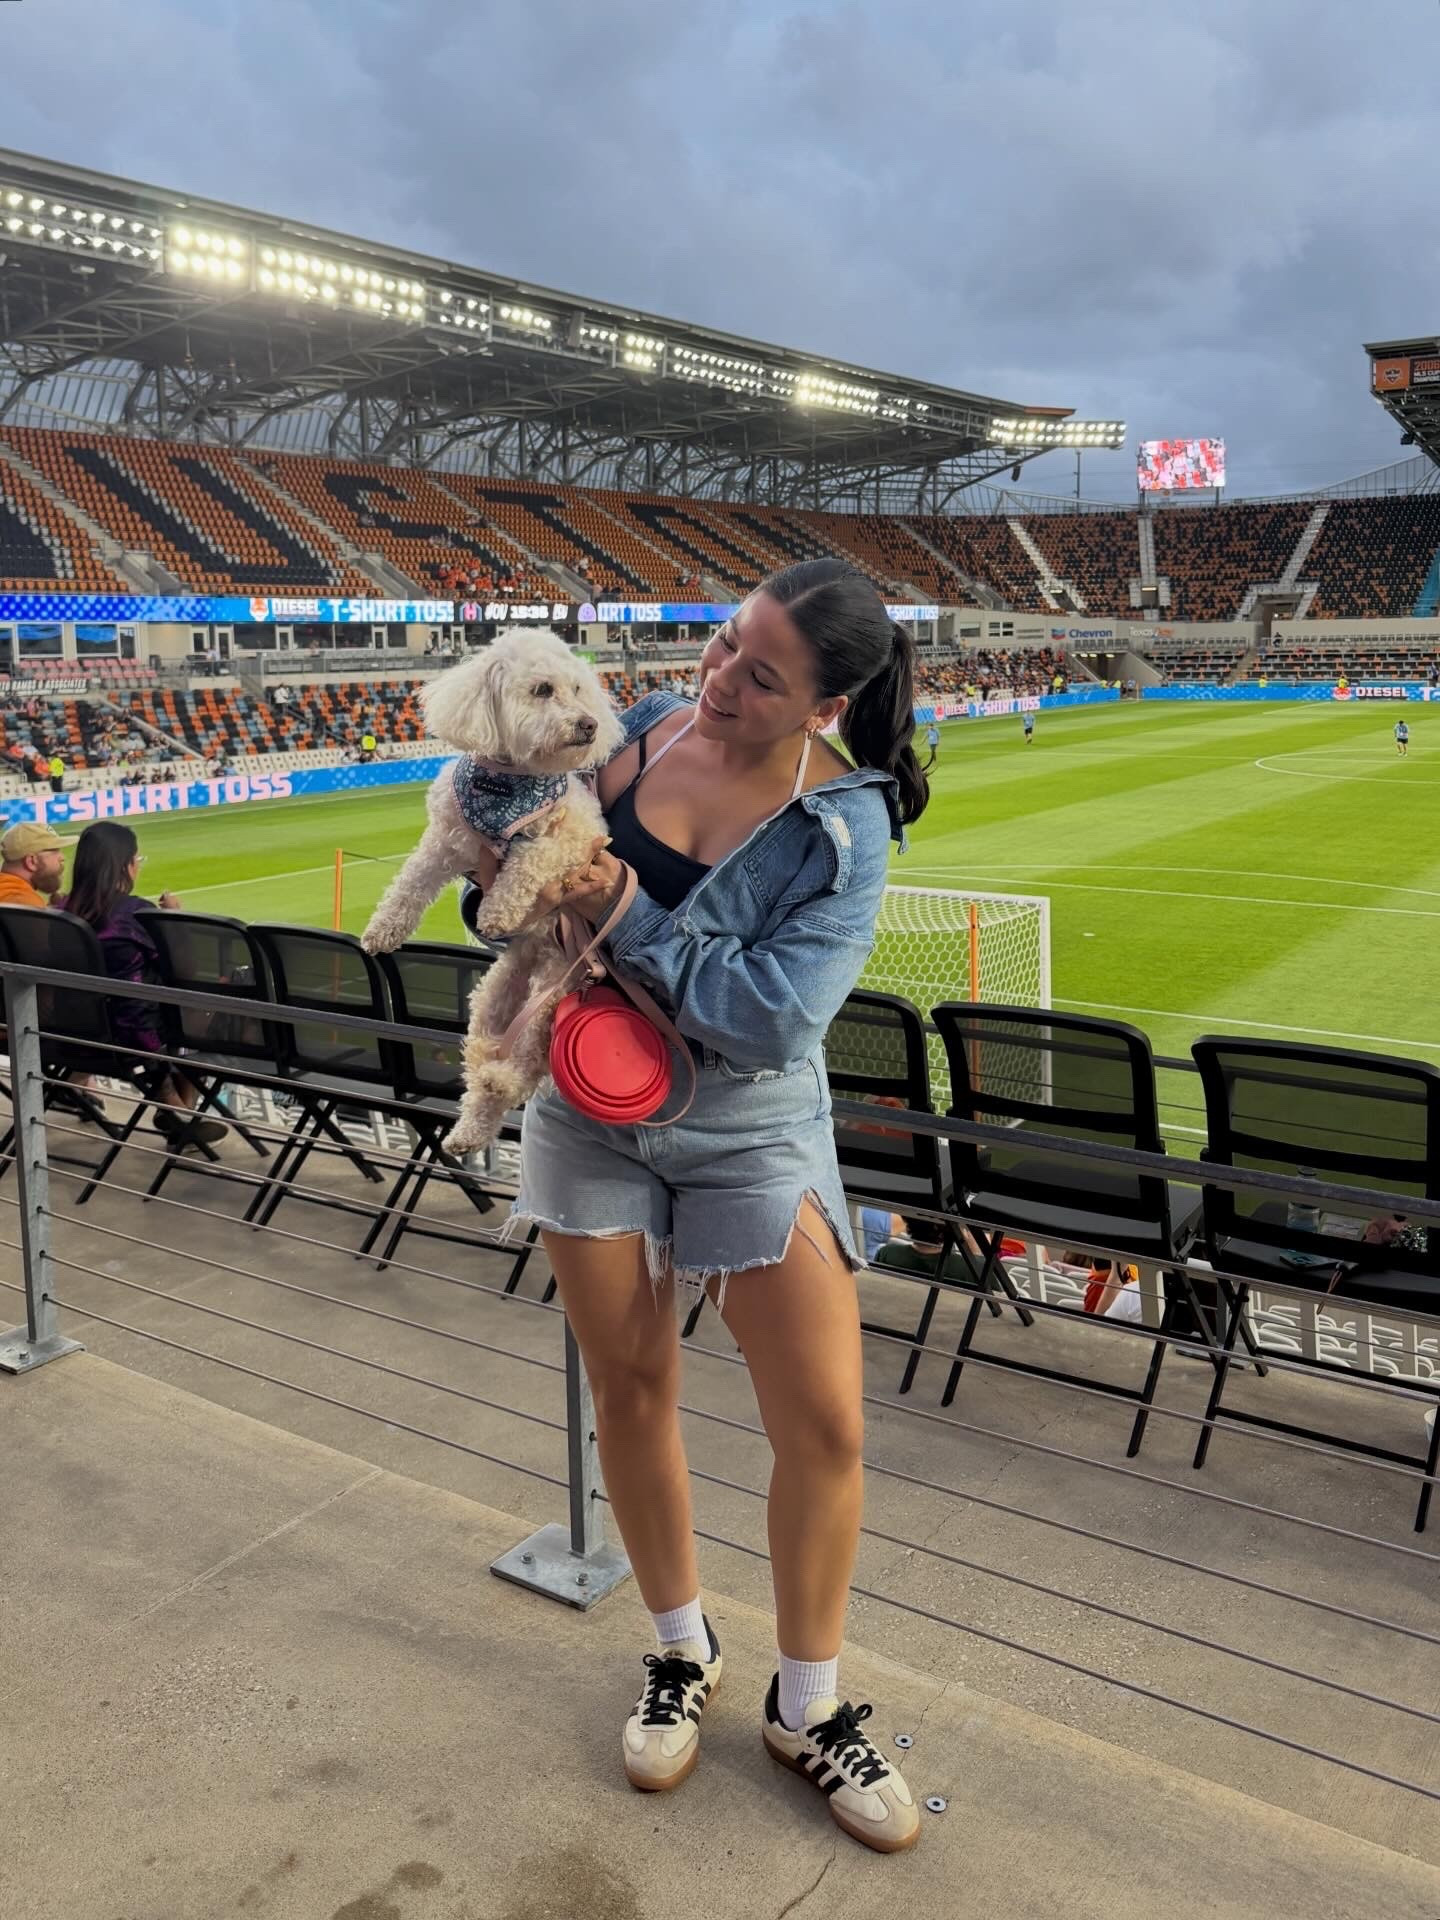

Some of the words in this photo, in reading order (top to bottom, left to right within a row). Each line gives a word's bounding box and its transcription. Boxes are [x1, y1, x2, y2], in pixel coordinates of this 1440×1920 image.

[272, 599, 321, 615] DIESEL
[331, 600, 410, 622] T-SHIRT
[598, 603, 627, 621] IRT
[628, 603, 662, 621] TOSS
[1069, 629, 1113, 638] Chevron
[45, 677, 87, 689] ASSOCIATES
[1356, 687, 1409, 697] DIESEL
[24, 781, 196, 825] T-SHIRT
[206, 772, 293, 804] TOSS
